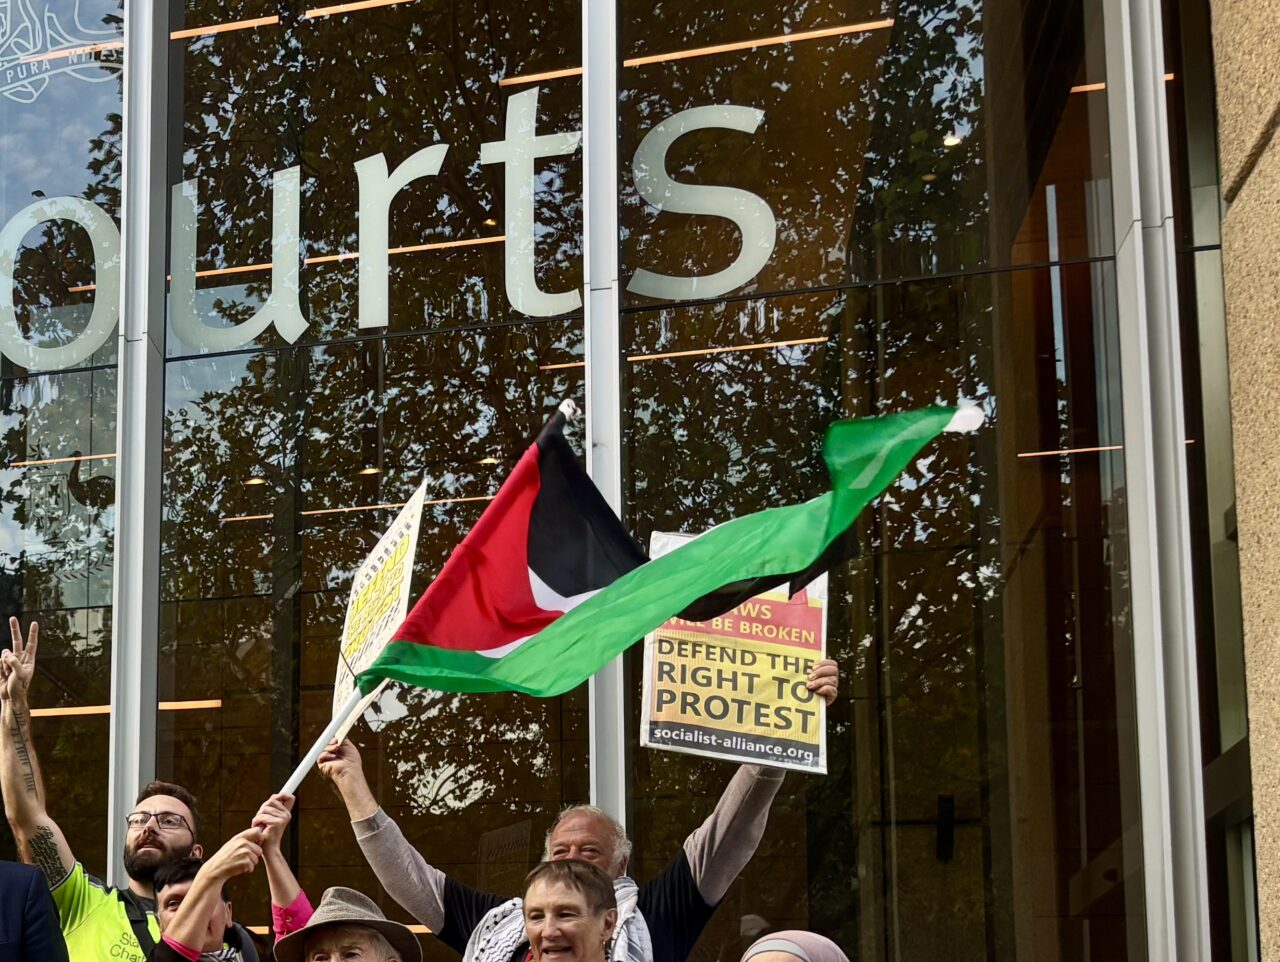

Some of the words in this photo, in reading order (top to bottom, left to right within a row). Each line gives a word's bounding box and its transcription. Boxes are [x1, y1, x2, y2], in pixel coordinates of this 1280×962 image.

[6, 59, 52, 84] PURA
[68, 46, 118, 65] NITES
[732, 602, 773, 620] WS
[712, 617, 734, 632] BE
[739, 621, 815, 645] BROKEN
[657, 638, 758, 667] DEFEND
[766, 652, 816, 676] THE
[657, 661, 761, 695] RIGHT
[772, 676, 816, 704] TO
[655, 689, 816, 735] PROTEST
[653, 727, 814, 763] socialist-alliance.org
[119, 932, 139, 948] Sta
